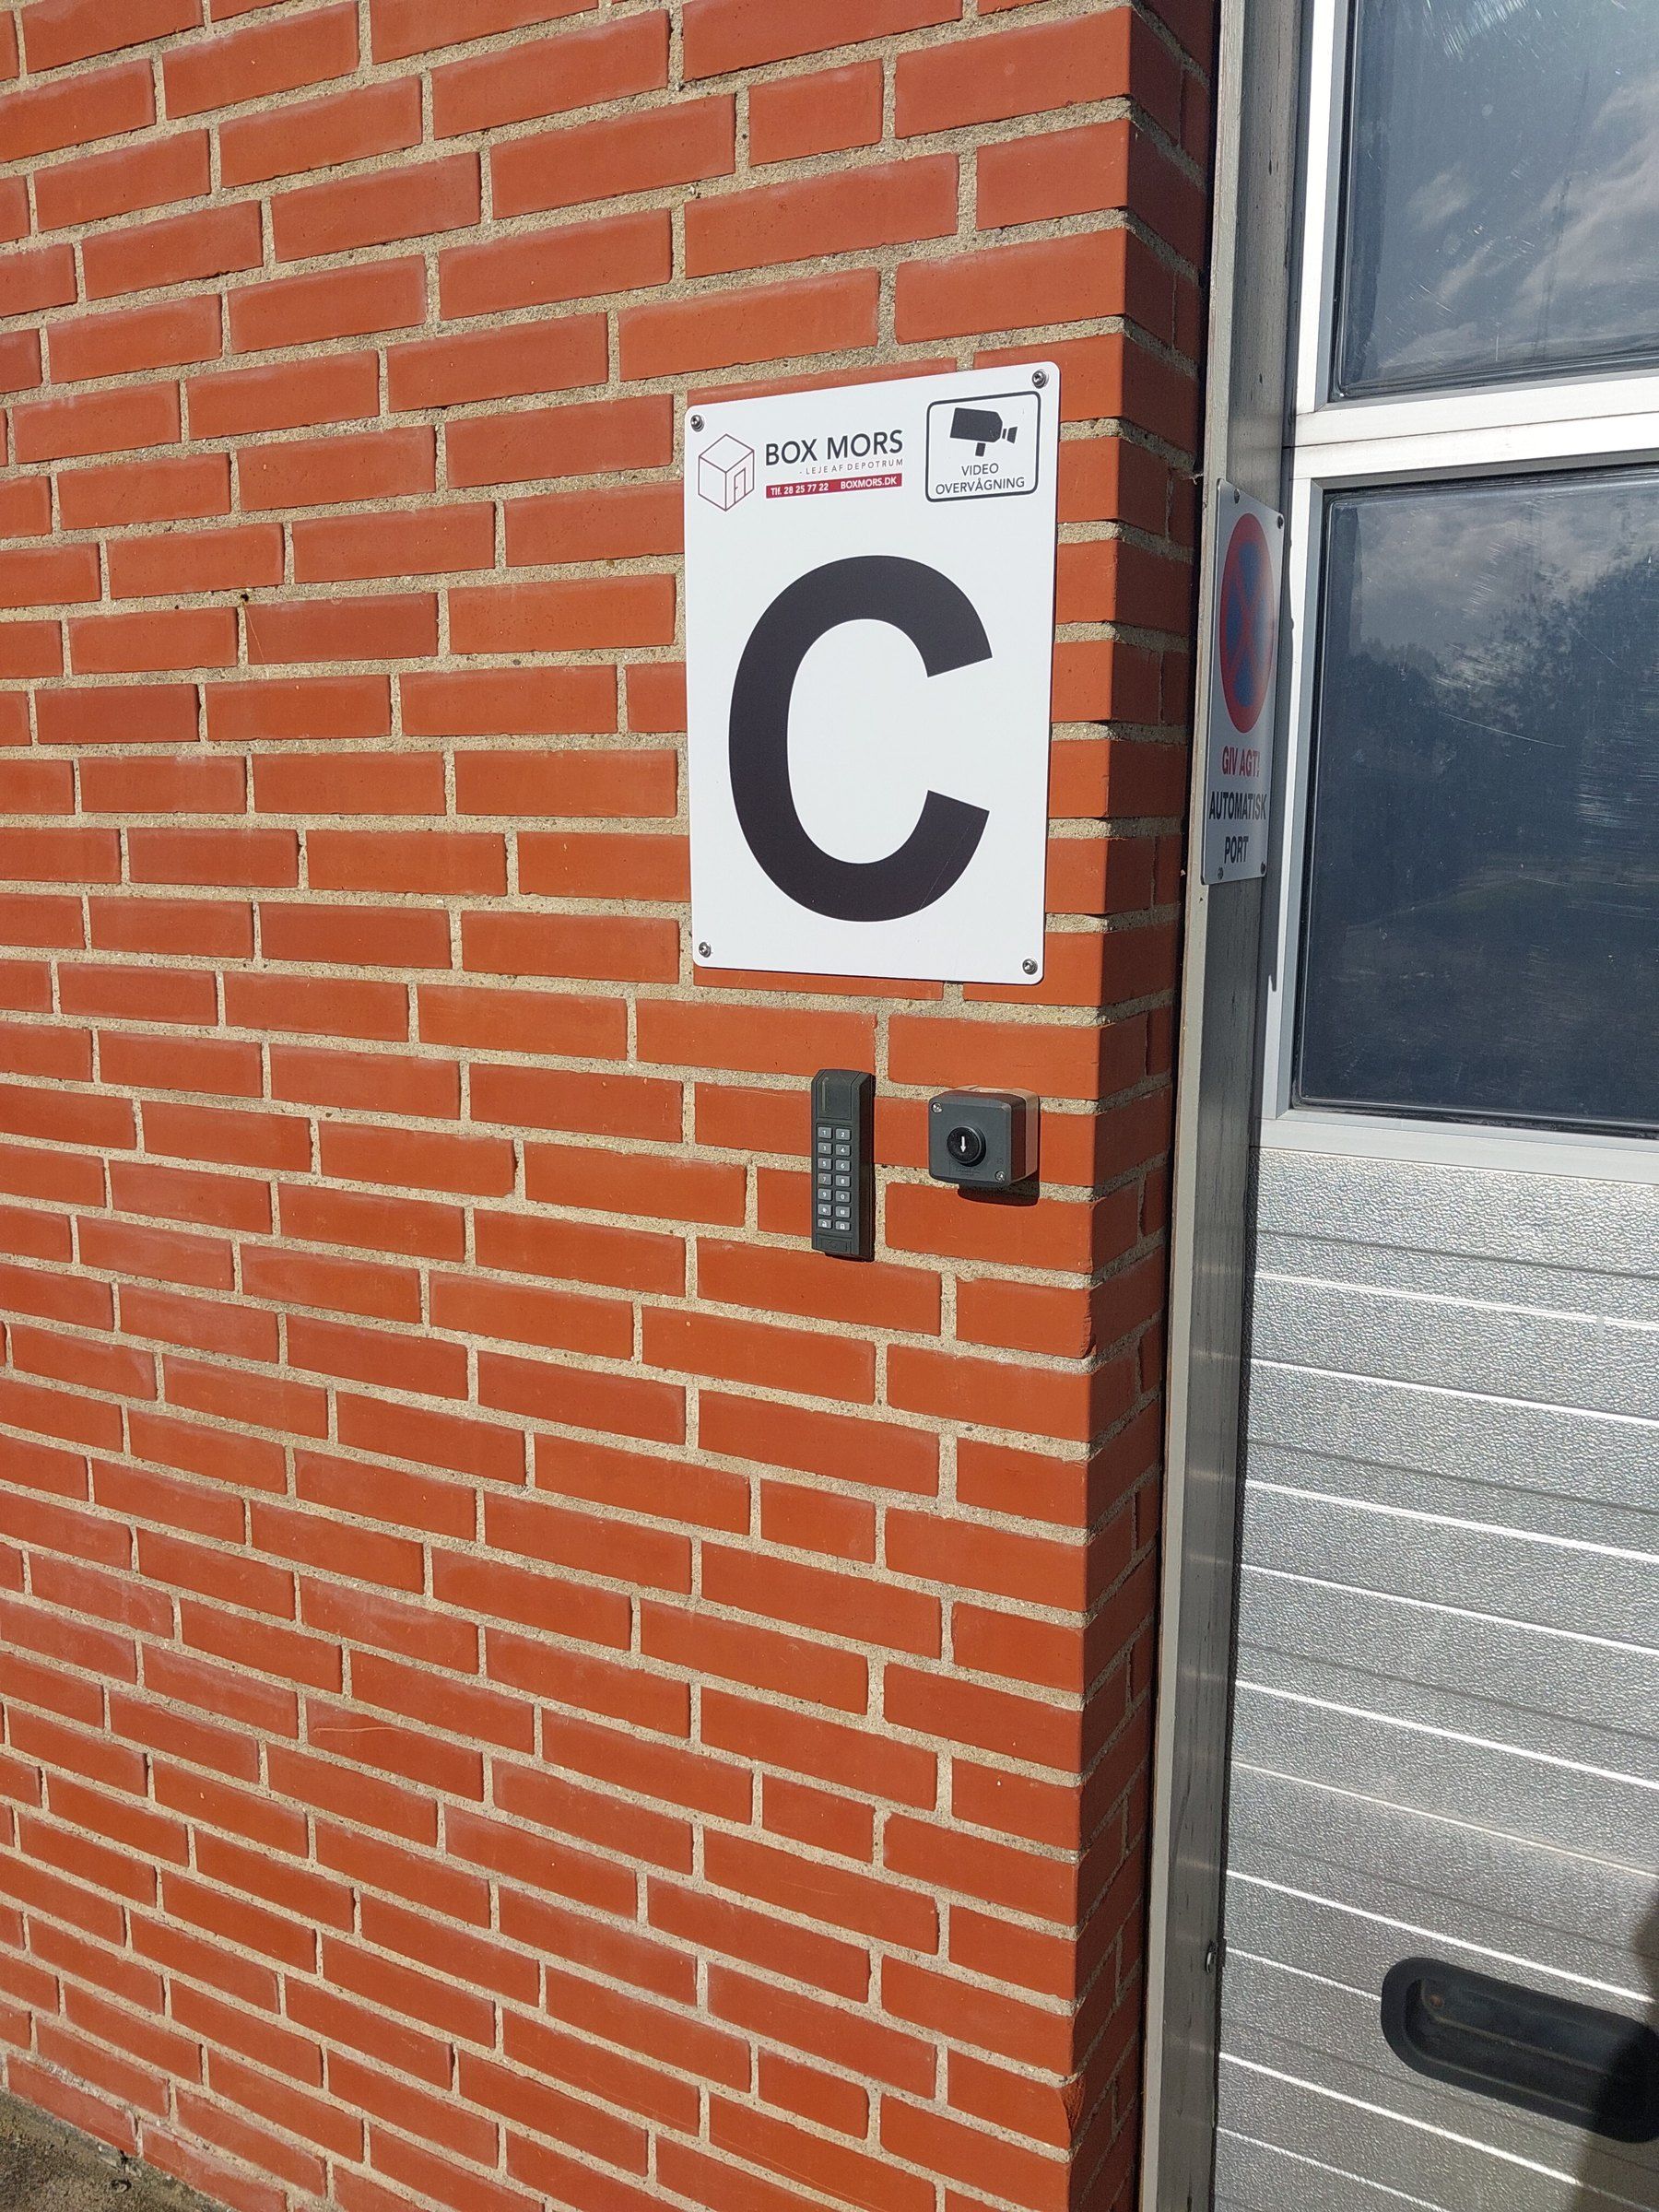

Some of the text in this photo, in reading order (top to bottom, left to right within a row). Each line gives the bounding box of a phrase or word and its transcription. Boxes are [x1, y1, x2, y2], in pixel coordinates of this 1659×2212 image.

[766, 429, 903, 466] BOX MORS
[806, 465, 828, 475] LEJE
[831, 464, 843, 473] AF
[847, 458, 903, 471] DEPOTRUM
[961, 463, 999, 477] VIDEO
[783, 485, 794, 495] 28
[795, 484, 806, 494] 25
[807, 483, 817, 493] 77
[818, 482, 829, 492] 22
[841, 477, 897, 489] BOXMORS.DK
[935, 477, 1025, 495] OVERVÅGNING
[728, 555, 993, 922] C
[1222, 745, 1260, 778] GIV AGT!
[1209, 791, 1267, 820] AUTOMATISK
[1224, 836, 1249, 864] PORT
